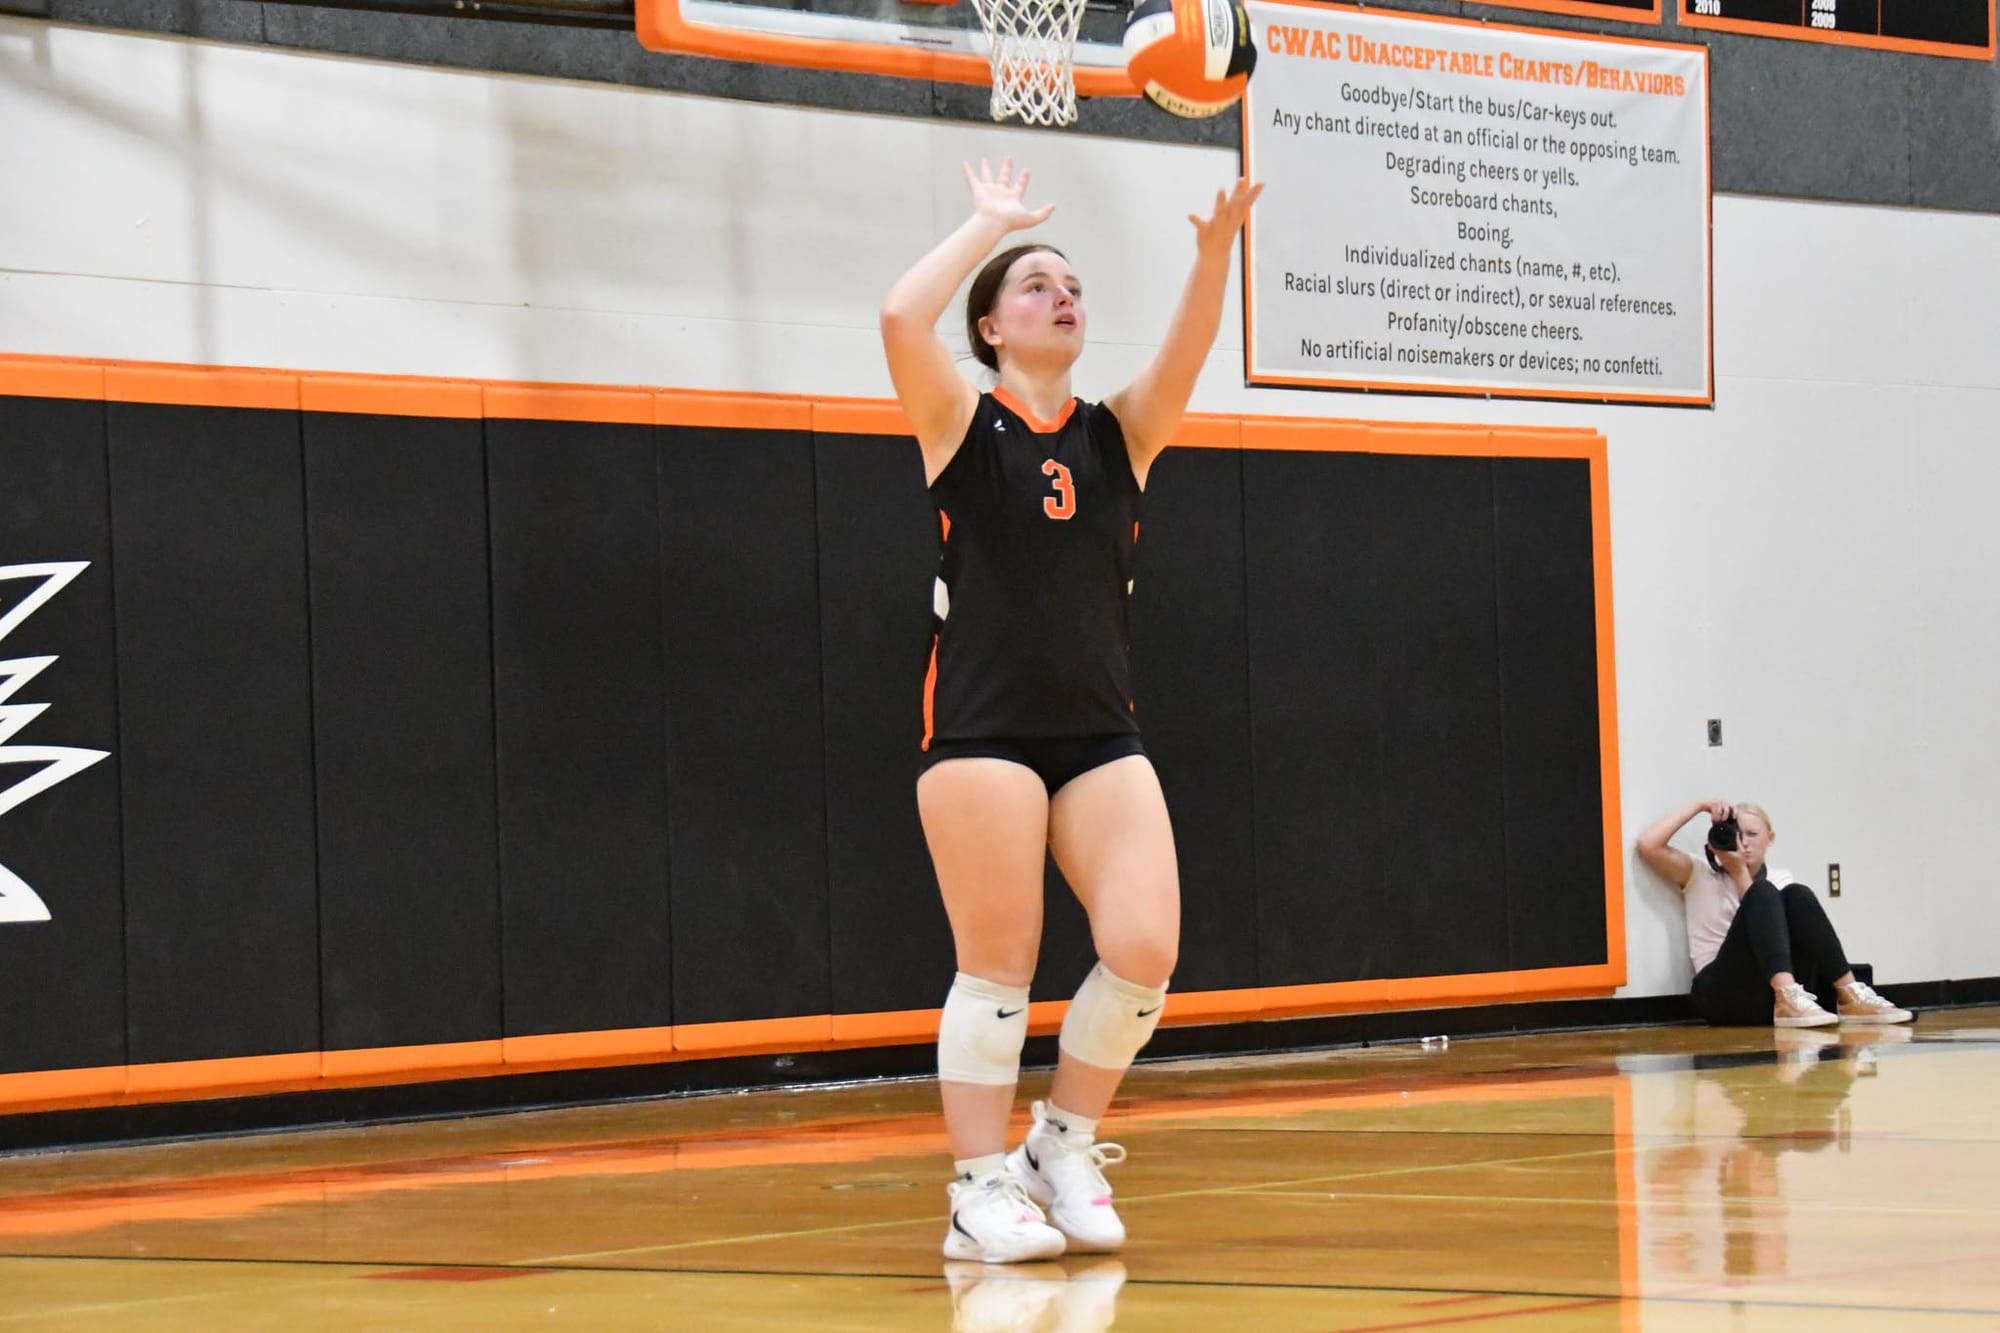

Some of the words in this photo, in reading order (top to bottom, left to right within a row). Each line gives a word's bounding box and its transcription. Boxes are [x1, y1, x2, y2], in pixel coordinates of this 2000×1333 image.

[1695, 0, 1721, 15] 2010
[1811, 11, 1836, 29] 2009
[1266, 24, 1341, 61] CWAC
[1340, 82, 1455, 113] Goodbye/Start
[1458, 94, 1484, 116] the
[1487, 96, 1587, 131] bus/Car-keys
[1589, 110, 1618, 129] out.
[1272, 107, 1302, 136] Any
[1305, 111, 1352, 135] chant
[1354, 115, 1420, 141] directed
[1424, 125, 1439, 143] at
[1443, 128, 1463, 145] an
[1466, 127, 1519, 151] official
[1523, 136, 1539, 152] or
[1541, 134, 1567, 155] the
[1569, 139, 1639, 167] opposing
[1641, 144, 1681, 165] team.
[1385, 151, 1467, 184] Degrading
[1469, 159, 1520, 182] cheers
[1523, 167, 1539, 183] or
[1541, 166, 1580, 191] yells.
[1410, 185, 1498, 211] Scoreboard
[1501, 192, 1558, 219] chants,
[1457, 220, 1515, 250] Booing.
[1344, 243, 1456, 271] Individualized
[1459, 252, 1513, 275] chants
[1516, 255, 1568, 282] (name,
[1571, 262, 1586, 283] #,
[1589, 261, 1621, 284] etc).
[1284, 271, 1332, 294] Racial
[1336, 275, 1376, 298] slurs
[1379, 276, 1432, 301] (direct
[1434, 286, 1452, 302] or
[1455, 282, 1526, 310] indirect),
[1528, 292, 1545, 308] or
[1548, 291, 1596, 311] sexual
[1599, 293, 1677, 317] references.
[1387, 311, 1528, 340] Profanity/obscene
[1530, 319, 1584, 342] cheers.
[1300, 337, 1322, 359] No
[1325, 338, 1393, 362] artificial
[1397, 343, 1495, 368] noisemakers
[1498, 353, 1516, 369] or
[1518, 349, 1579, 375] devices;
[1583, 358, 1601, 373] no
[1603, 355, 1663, 376] confetti.
[1041, 458, 1077, 520] 3
